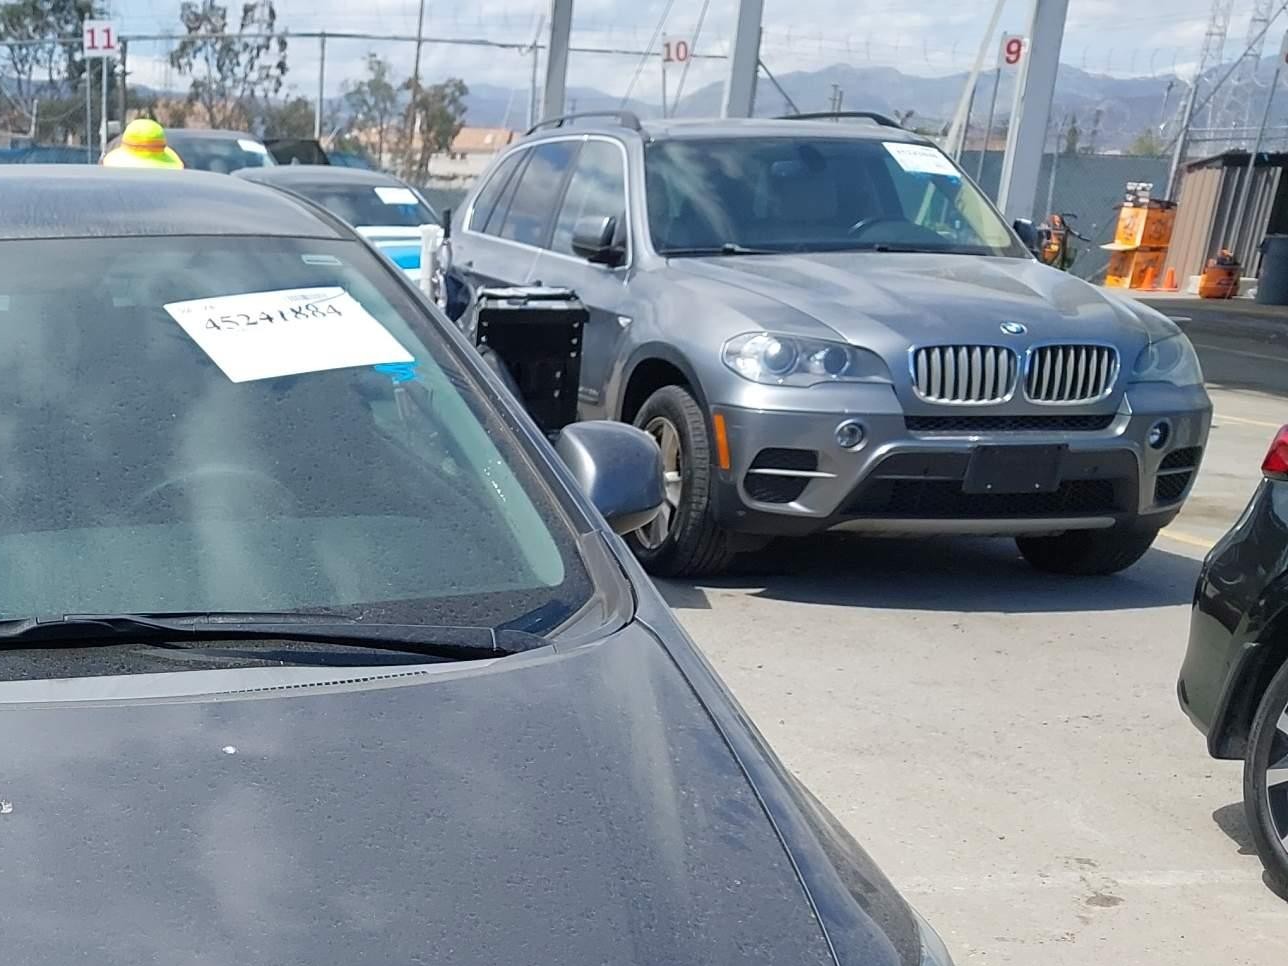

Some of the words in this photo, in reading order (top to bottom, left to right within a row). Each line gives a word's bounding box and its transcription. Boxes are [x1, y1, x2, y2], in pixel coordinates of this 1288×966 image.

[87, 28, 114, 49] 11
[663, 41, 688, 62] 10
[1006, 39, 1022, 64] 9
